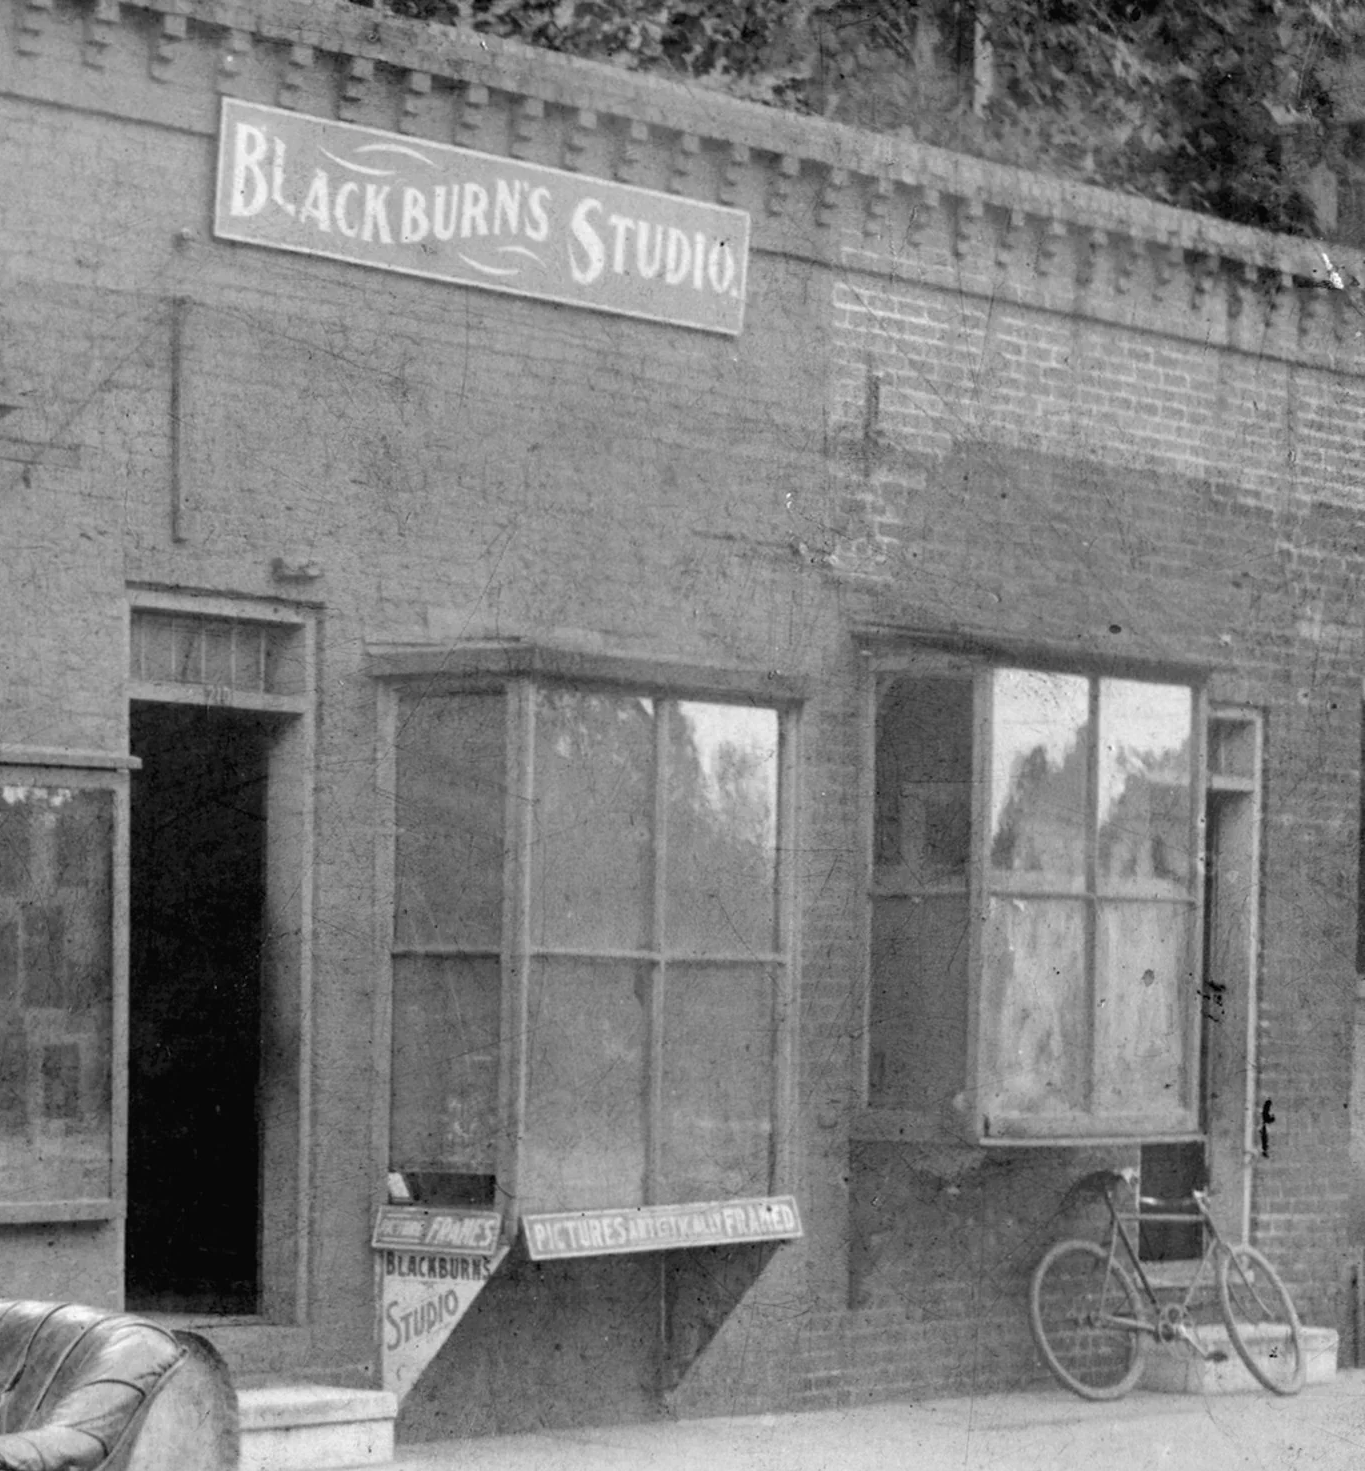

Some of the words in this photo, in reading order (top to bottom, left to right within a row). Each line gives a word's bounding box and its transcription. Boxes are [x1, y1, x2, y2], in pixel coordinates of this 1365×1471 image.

[230, 122, 551, 244] BLACKBURN'S
[532, 1216, 627, 1251] PICTURES
[722, 1203, 796, 1237] FRAMED
[386, 1289, 459, 1351] STUDIO
